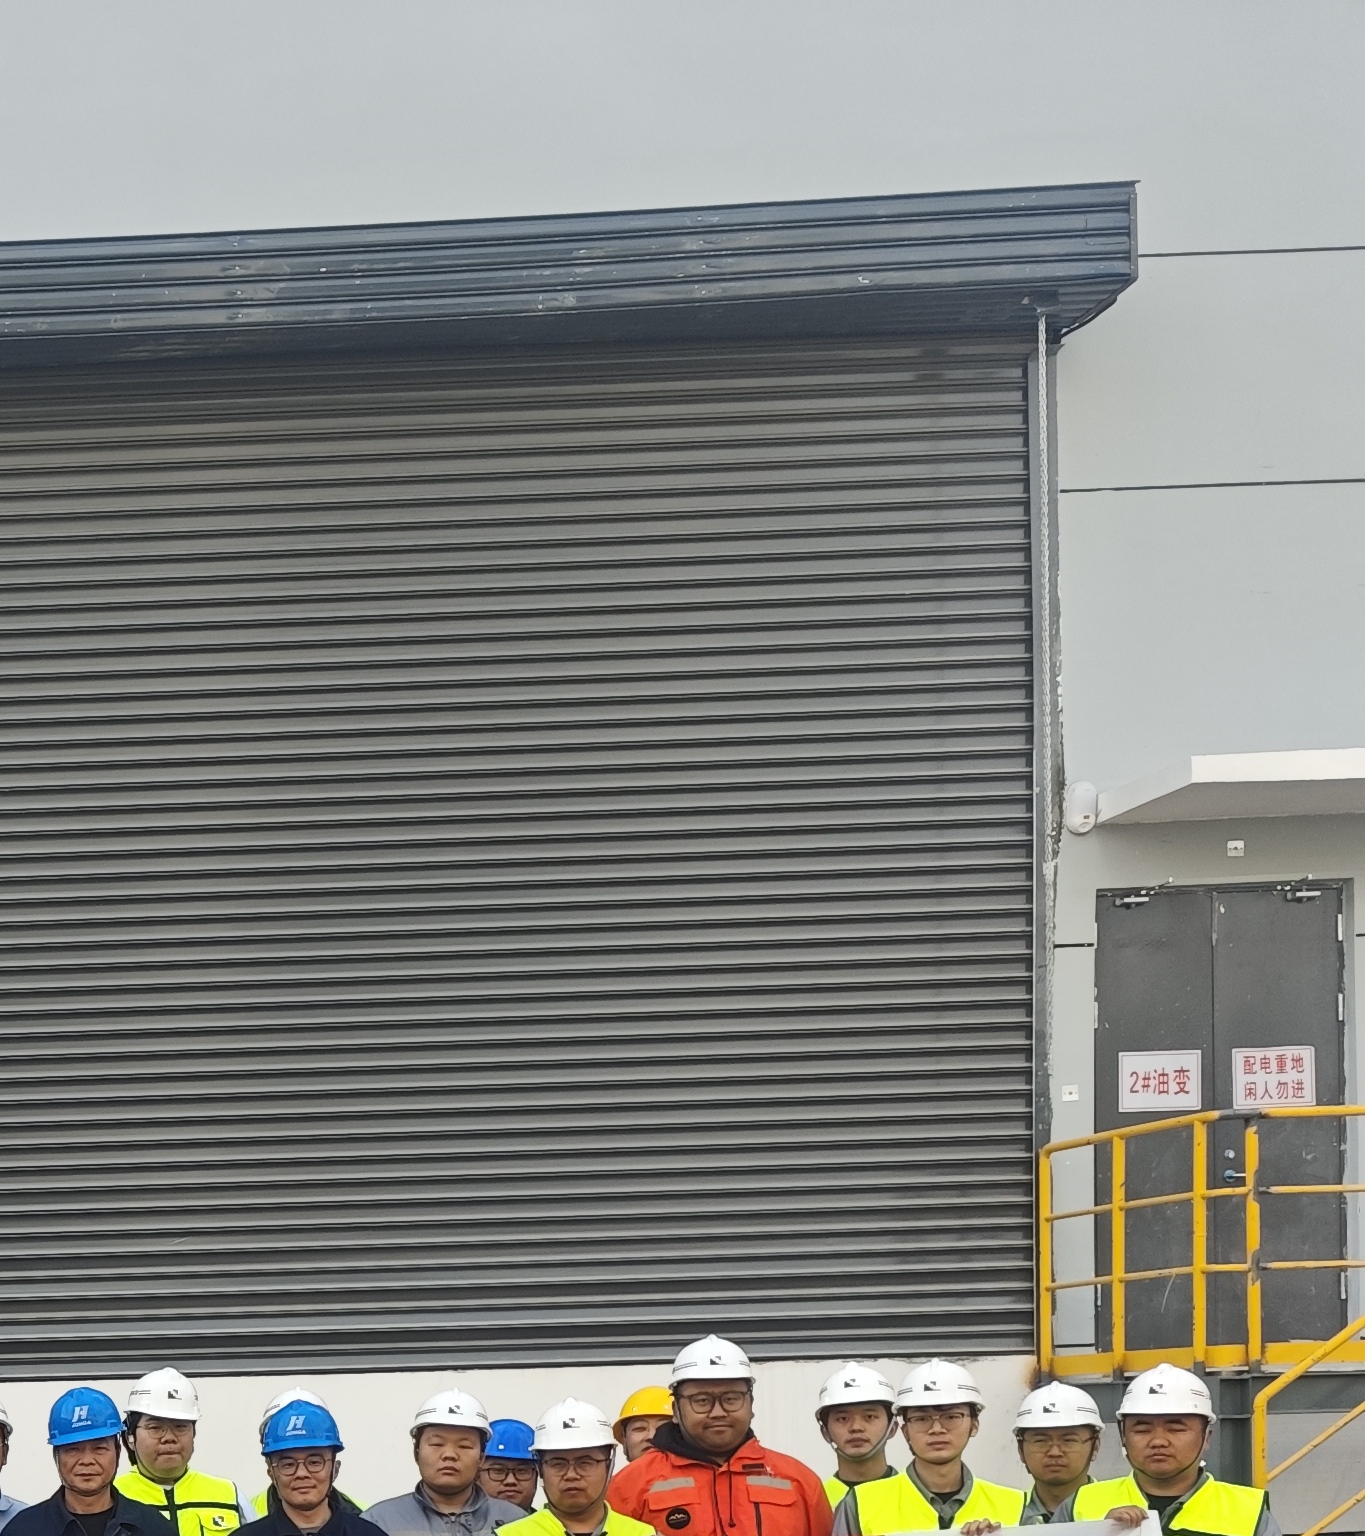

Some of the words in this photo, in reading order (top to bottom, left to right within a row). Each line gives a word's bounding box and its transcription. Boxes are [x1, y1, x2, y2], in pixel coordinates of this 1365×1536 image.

[1243, 1053, 1305, 1075] 配电重地
[1129, 1066, 1191, 1095] 2#油变
[1244, 1079, 1306, 1101] 闲人勿进
